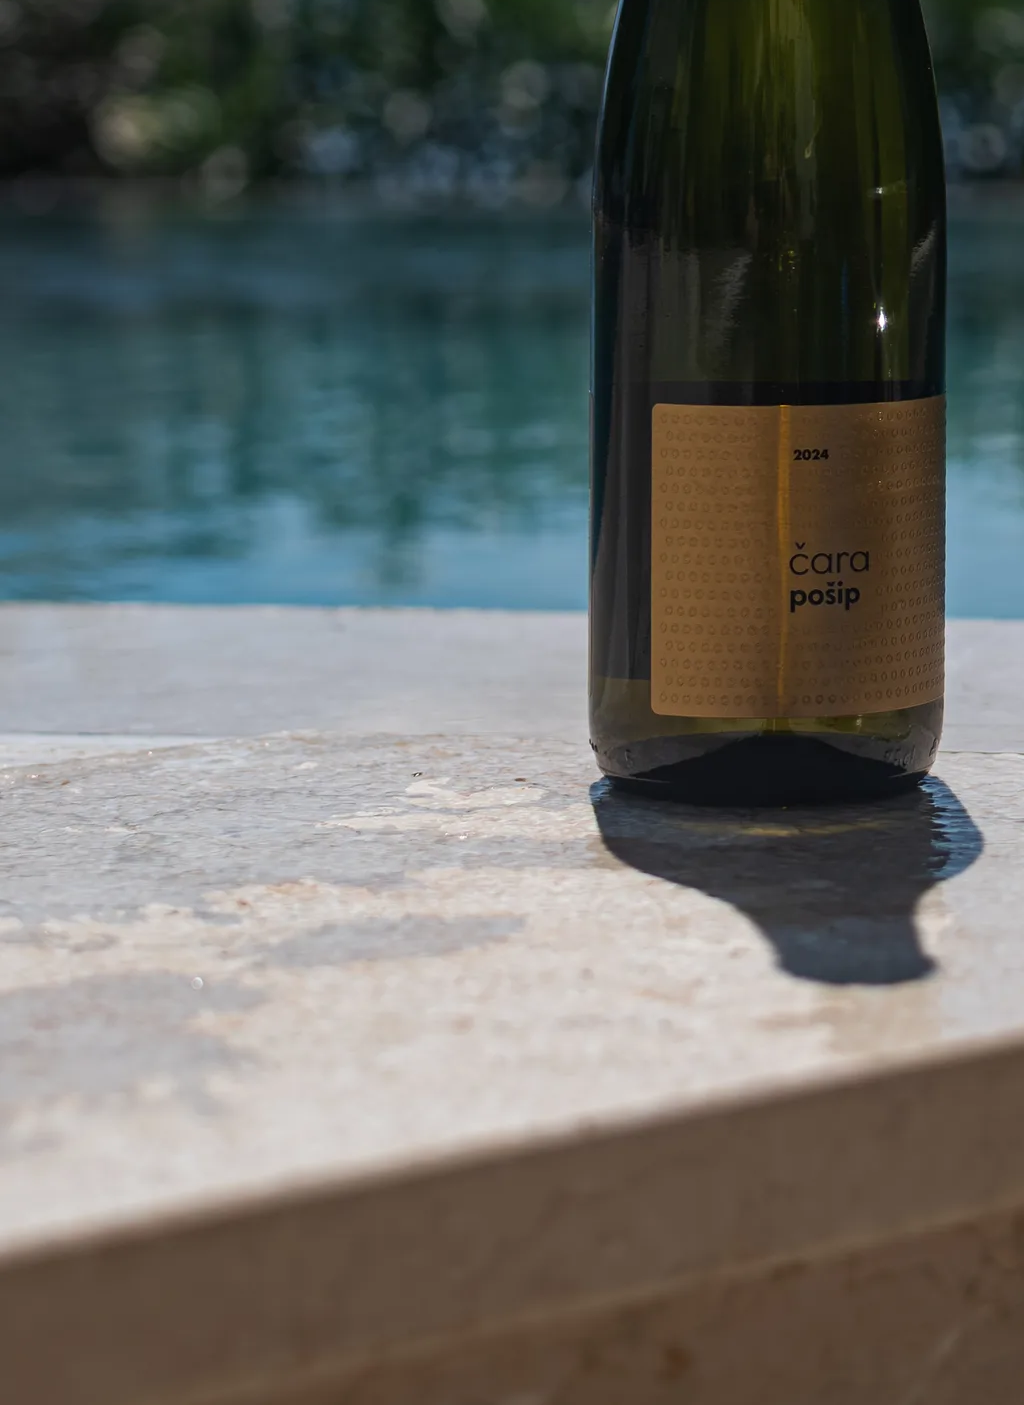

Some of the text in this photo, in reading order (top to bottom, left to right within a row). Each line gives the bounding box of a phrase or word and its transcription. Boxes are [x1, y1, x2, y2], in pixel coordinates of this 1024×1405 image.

[793, 449, 829, 461] 2024
[789, 542, 870, 576] čara
[790, 581, 860, 612] pošip
